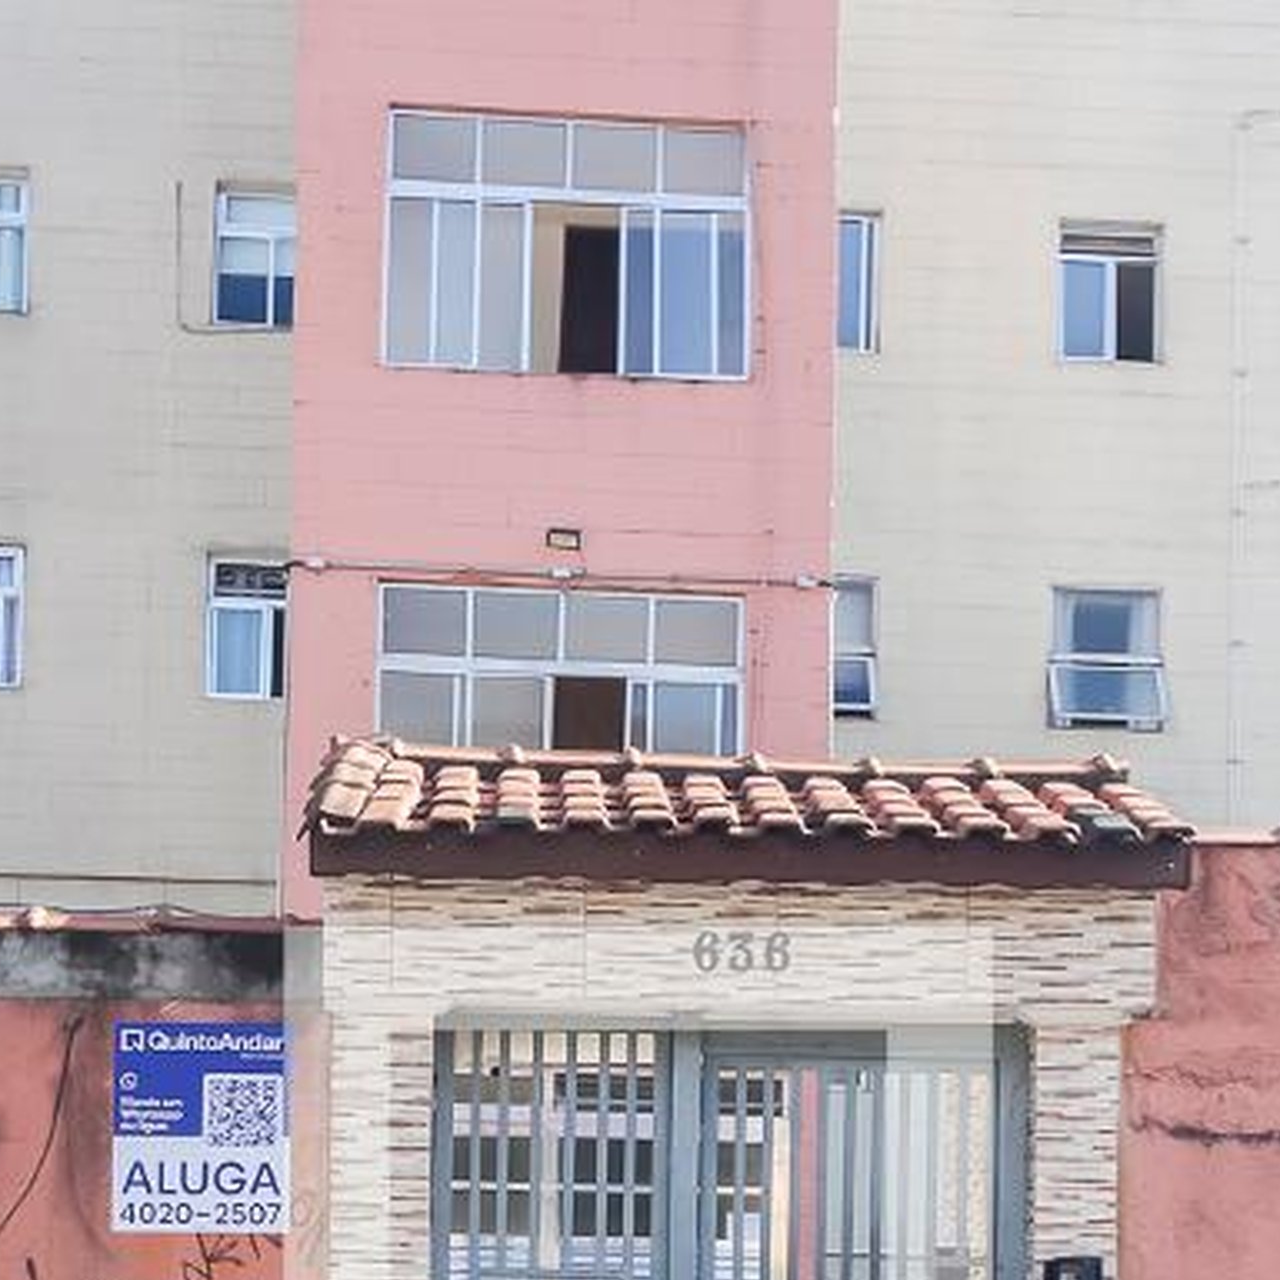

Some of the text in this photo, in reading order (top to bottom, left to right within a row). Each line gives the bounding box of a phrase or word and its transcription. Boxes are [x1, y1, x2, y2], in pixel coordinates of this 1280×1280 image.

[693, 931, 790, 971] 636
[122, 1161, 281, 1196] ALUGA
[120, 1202, 282, 1226] 4020-2507
